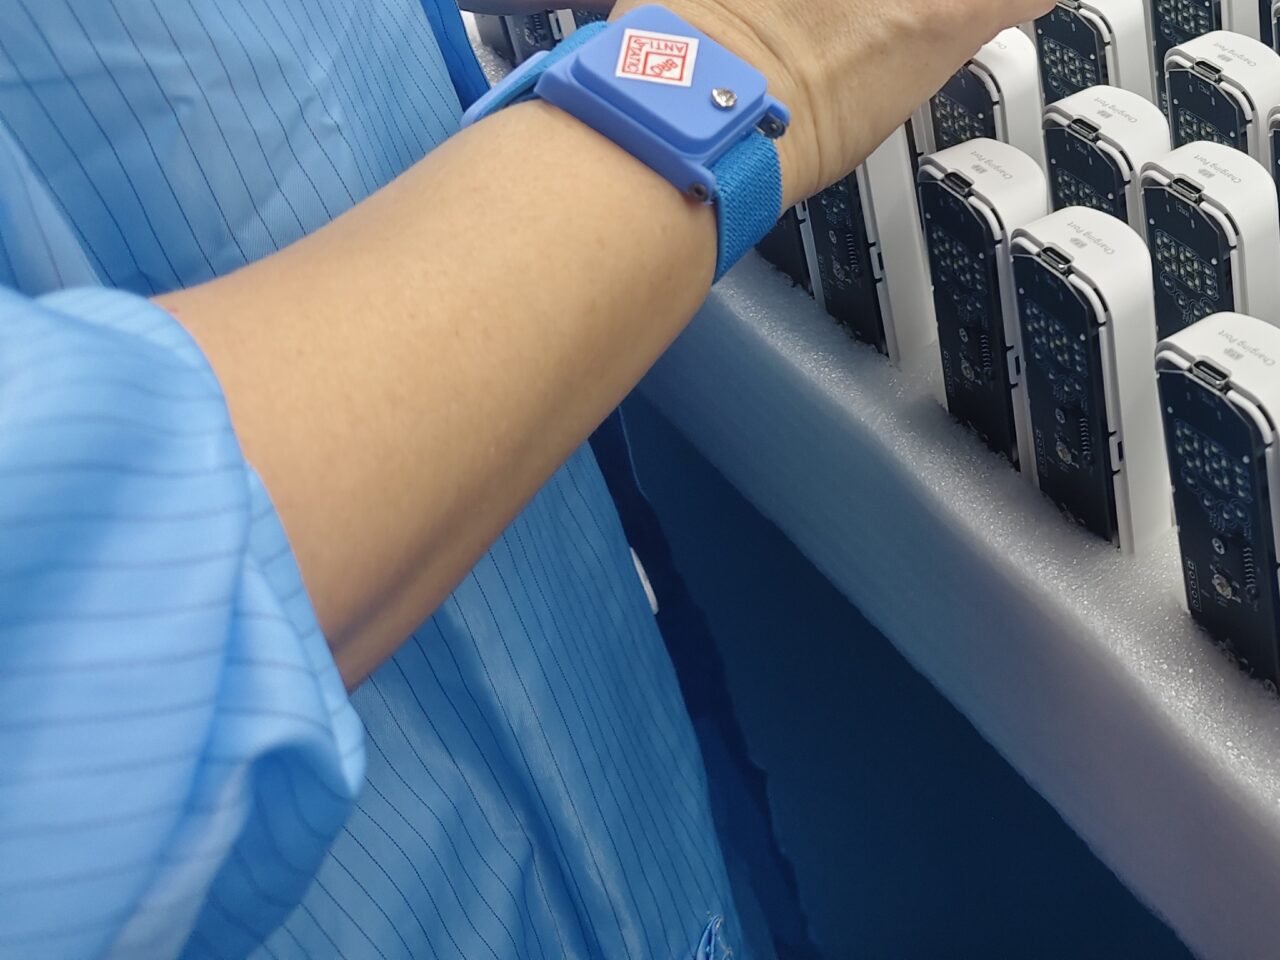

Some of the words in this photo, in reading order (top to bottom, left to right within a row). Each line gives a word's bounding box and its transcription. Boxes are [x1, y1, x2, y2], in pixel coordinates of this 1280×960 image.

[627, 39, 644, 73] STATIC
[1226, 48, 1257, 68] Charging
[1107, 103, 1139, 124] Charging
[983, 159, 1014, 180] Charging
[1208, 162, 1243, 184] Charging
[1082, 230, 1116, 256] Charging
[1217, 329, 1239, 344] Port
[1236, 340, 1277, 367] Charging
